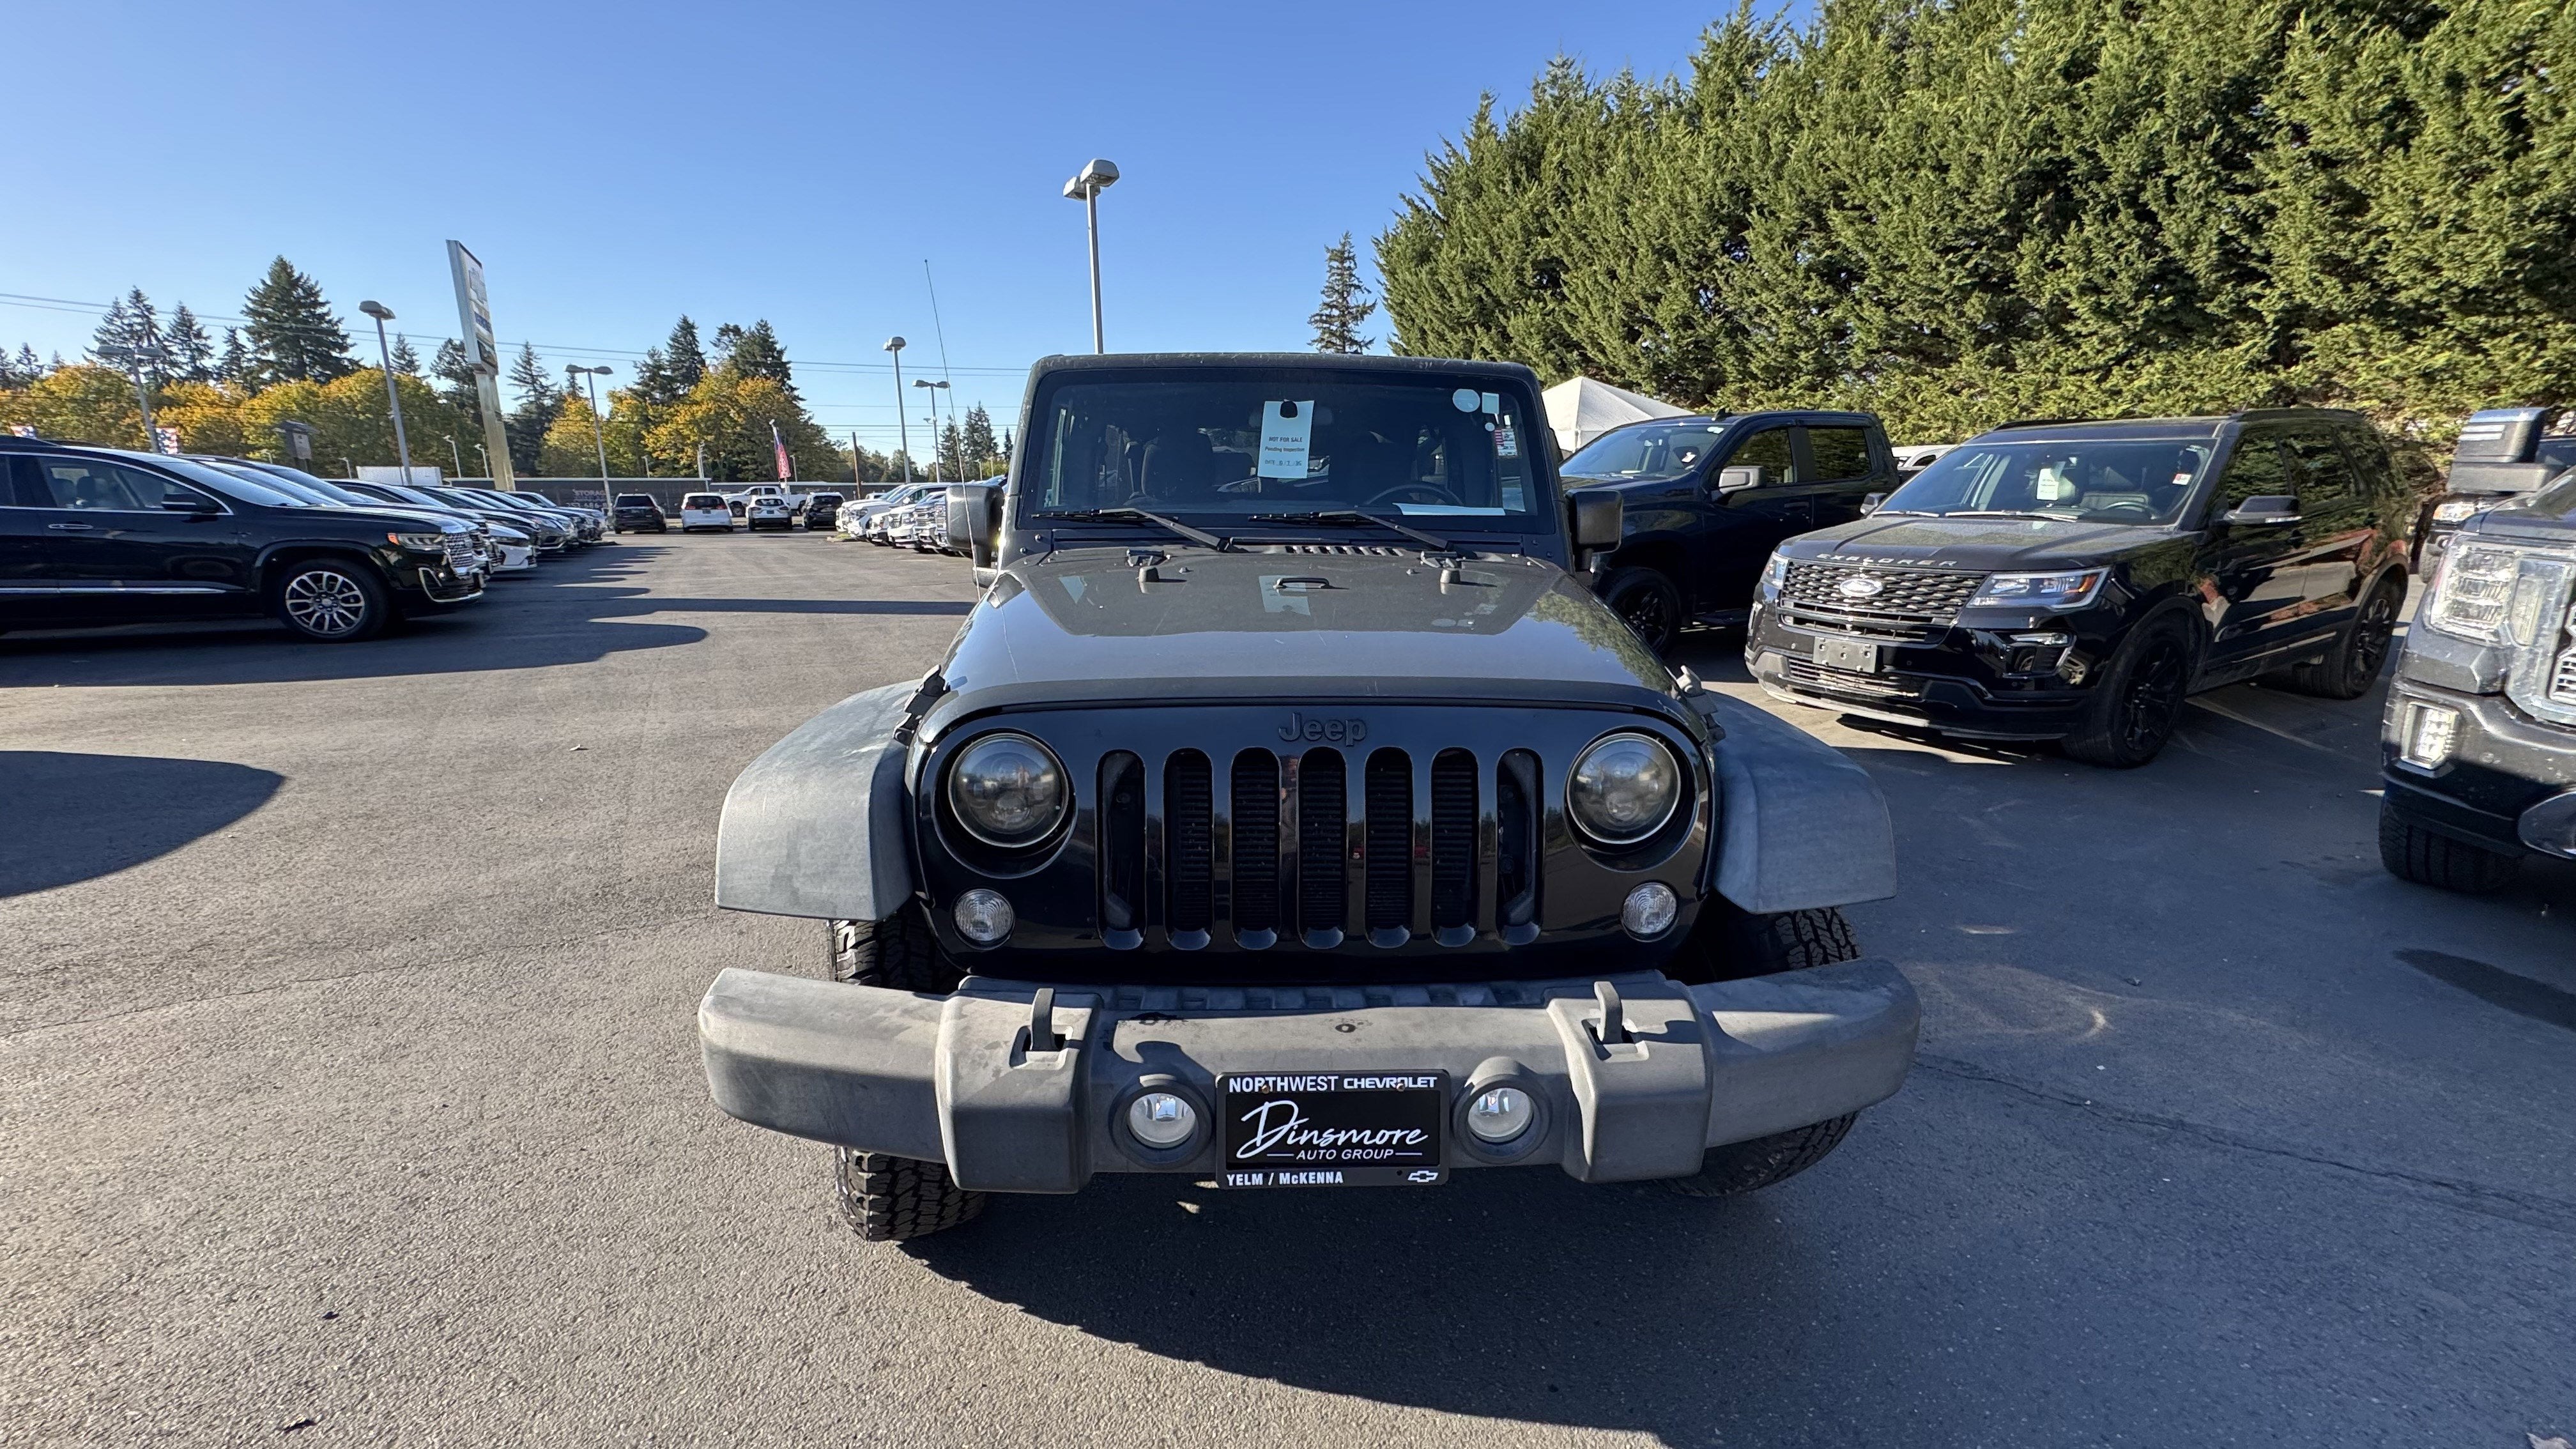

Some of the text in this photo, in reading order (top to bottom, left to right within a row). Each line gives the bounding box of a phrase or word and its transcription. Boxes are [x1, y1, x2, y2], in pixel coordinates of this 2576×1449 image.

[1816, 553, 1958, 567] EXPLORER
[1278, 712, 1367, 747] Jeep
[1229, 1076, 1438, 1093] NORTHWEST CHEVROLET
[1236, 1100, 1429, 1159] Dinsmore
[1296, 1149, 1394, 1160] AUTO GROUP
[1226, 1172, 1264, 1186] YELM
[1278, 1170, 1344, 1186] McKENNA
